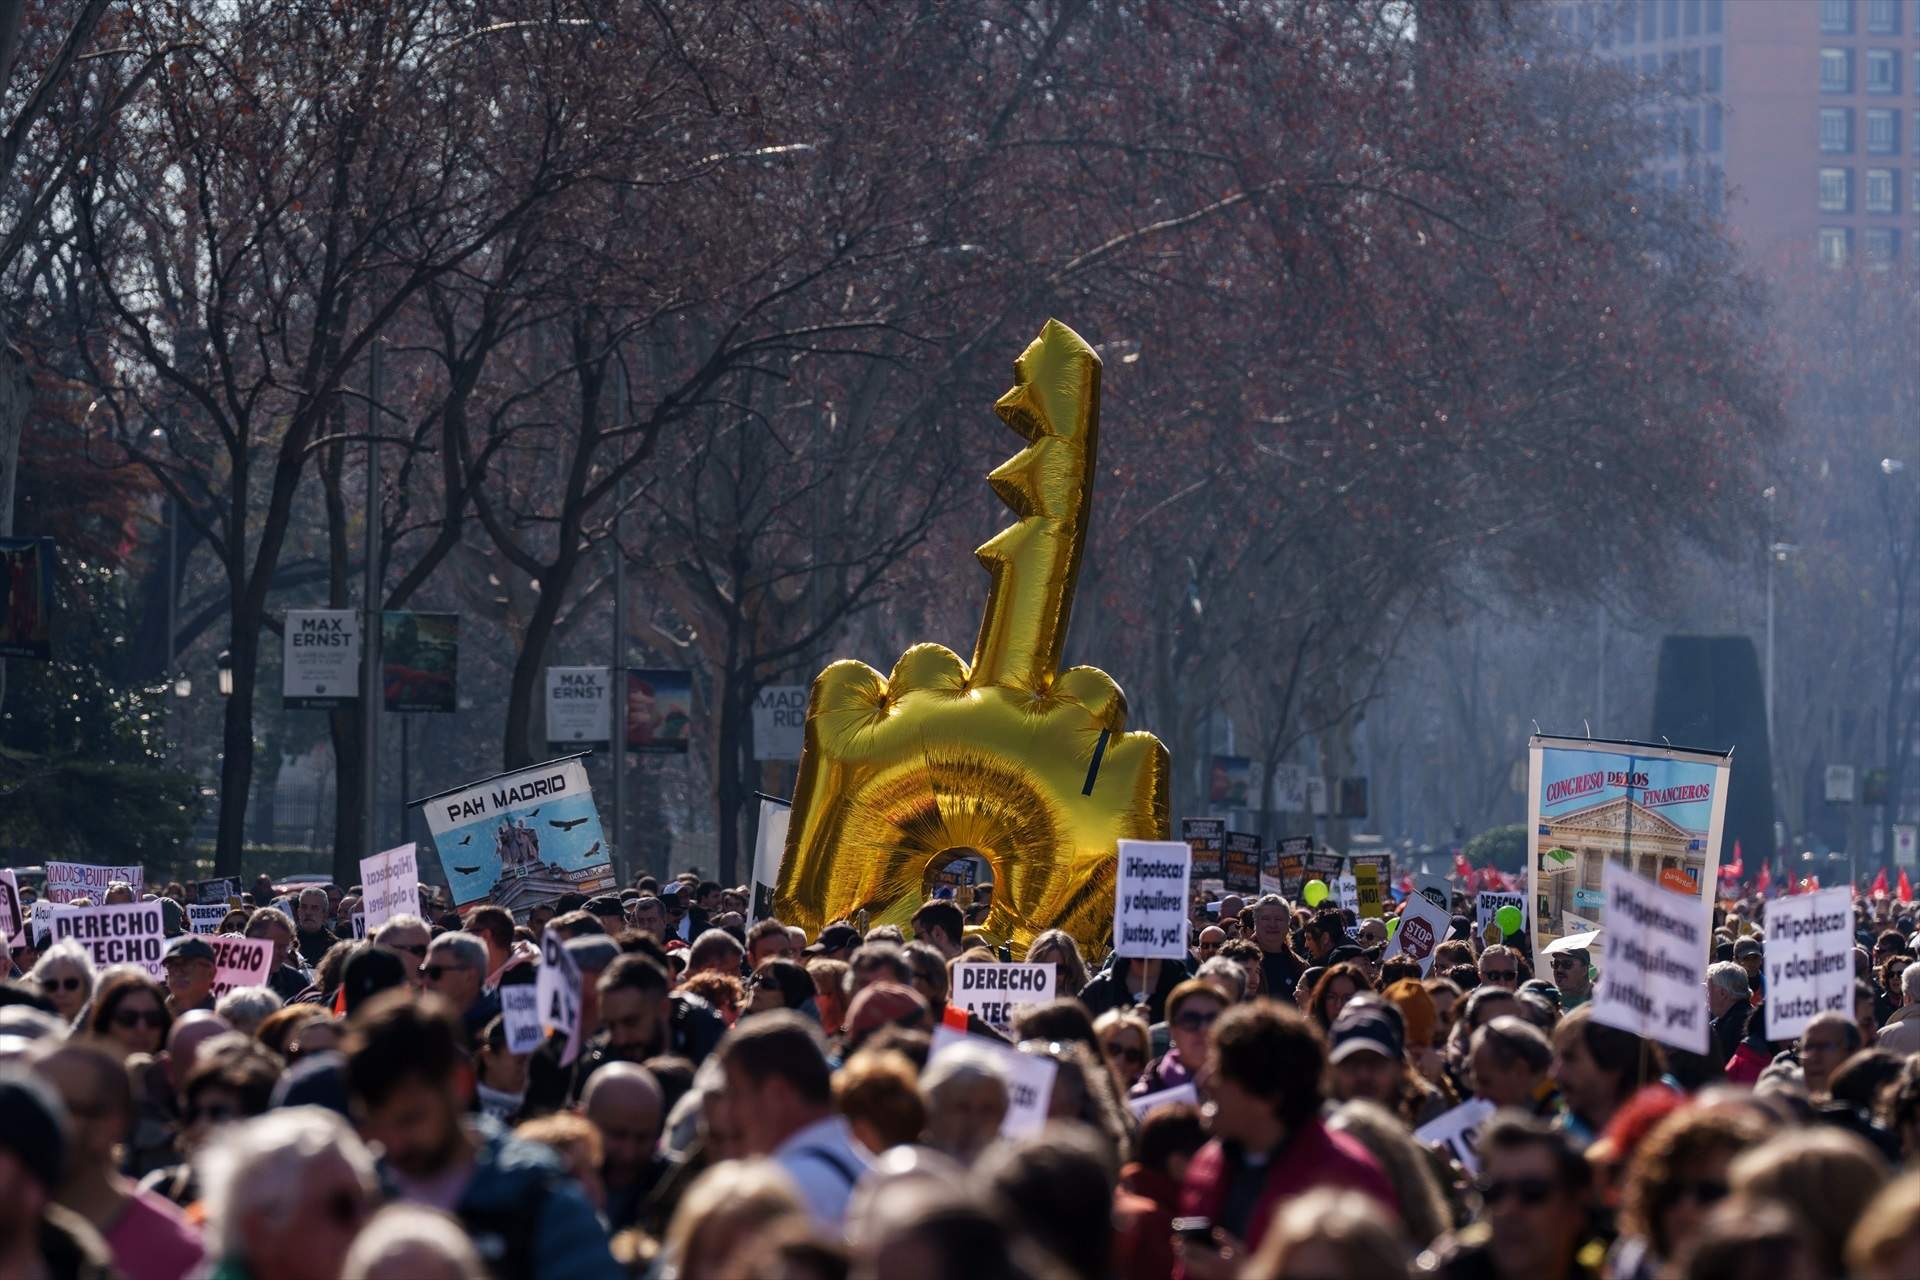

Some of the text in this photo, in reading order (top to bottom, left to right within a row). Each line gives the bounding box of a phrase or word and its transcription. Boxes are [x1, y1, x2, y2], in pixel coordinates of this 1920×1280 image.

[302, 618, 342, 632] MAX
[292, 633, 352, 647] ERNST
[560, 675, 595, 686] MAX
[553, 687, 604, 699] ERNST
[447, 774, 566, 822] PAH MADRID
[1546, 771, 1604, 802] CONGRESO
[1643, 783, 1710, 805] FINANCIEROS
[1126, 856, 1185, 881] ¡Hipotecas
[190, 907, 227, 919] DERECHO
[1124, 889, 1182, 915] y alquileres
[56, 910, 159, 940] DERECHO
[1122, 922, 1181, 948] justos, ya!
[1406, 920, 1433, 943] STOP
[962, 968, 1046, 991] DERECHO
[1772, 963, 1781, 987] y
